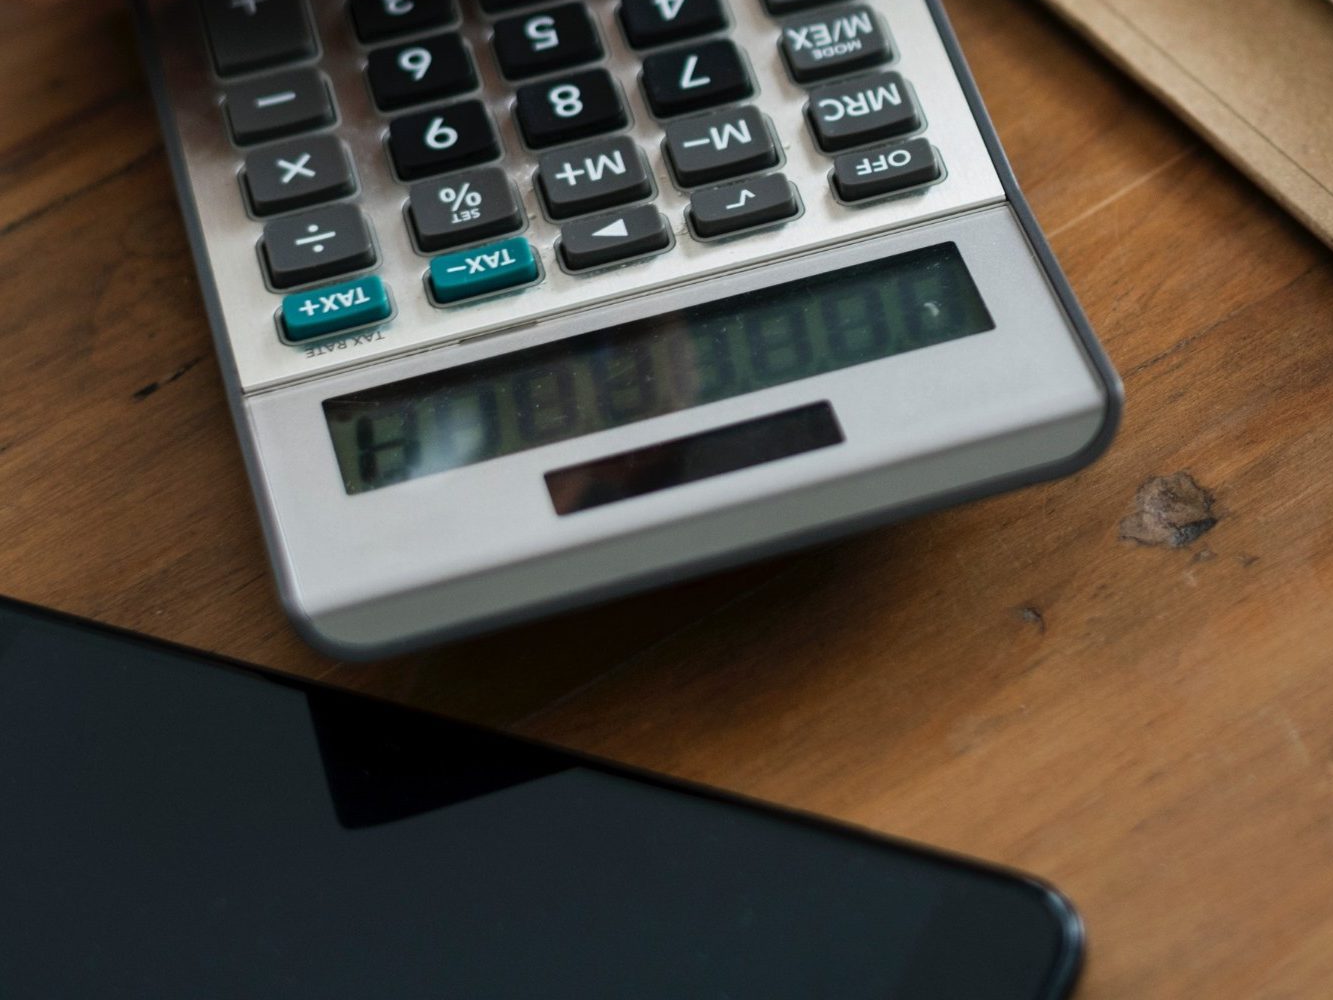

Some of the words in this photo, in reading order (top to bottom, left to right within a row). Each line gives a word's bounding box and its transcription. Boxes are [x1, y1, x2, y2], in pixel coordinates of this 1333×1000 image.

[524, 16, 559, 50] 5
[784, 12, 874, 52] M/EX
[810, 39, 862, 61] MODE
[678, 54, 711, 89] 7
[548, 84, 584, 118] 8
[818, 83, 902, 121] MRC
[555, 150, 626, 186] M+
[855, 149, 912, 176] OFF
[439, 182, 482, 211] %
[449, 207, 481, 224] SET
[298, 286, 370, 316] TAX+
[304, 340, 349, 360] RATE
[352, 330, 385, 348] TAX
